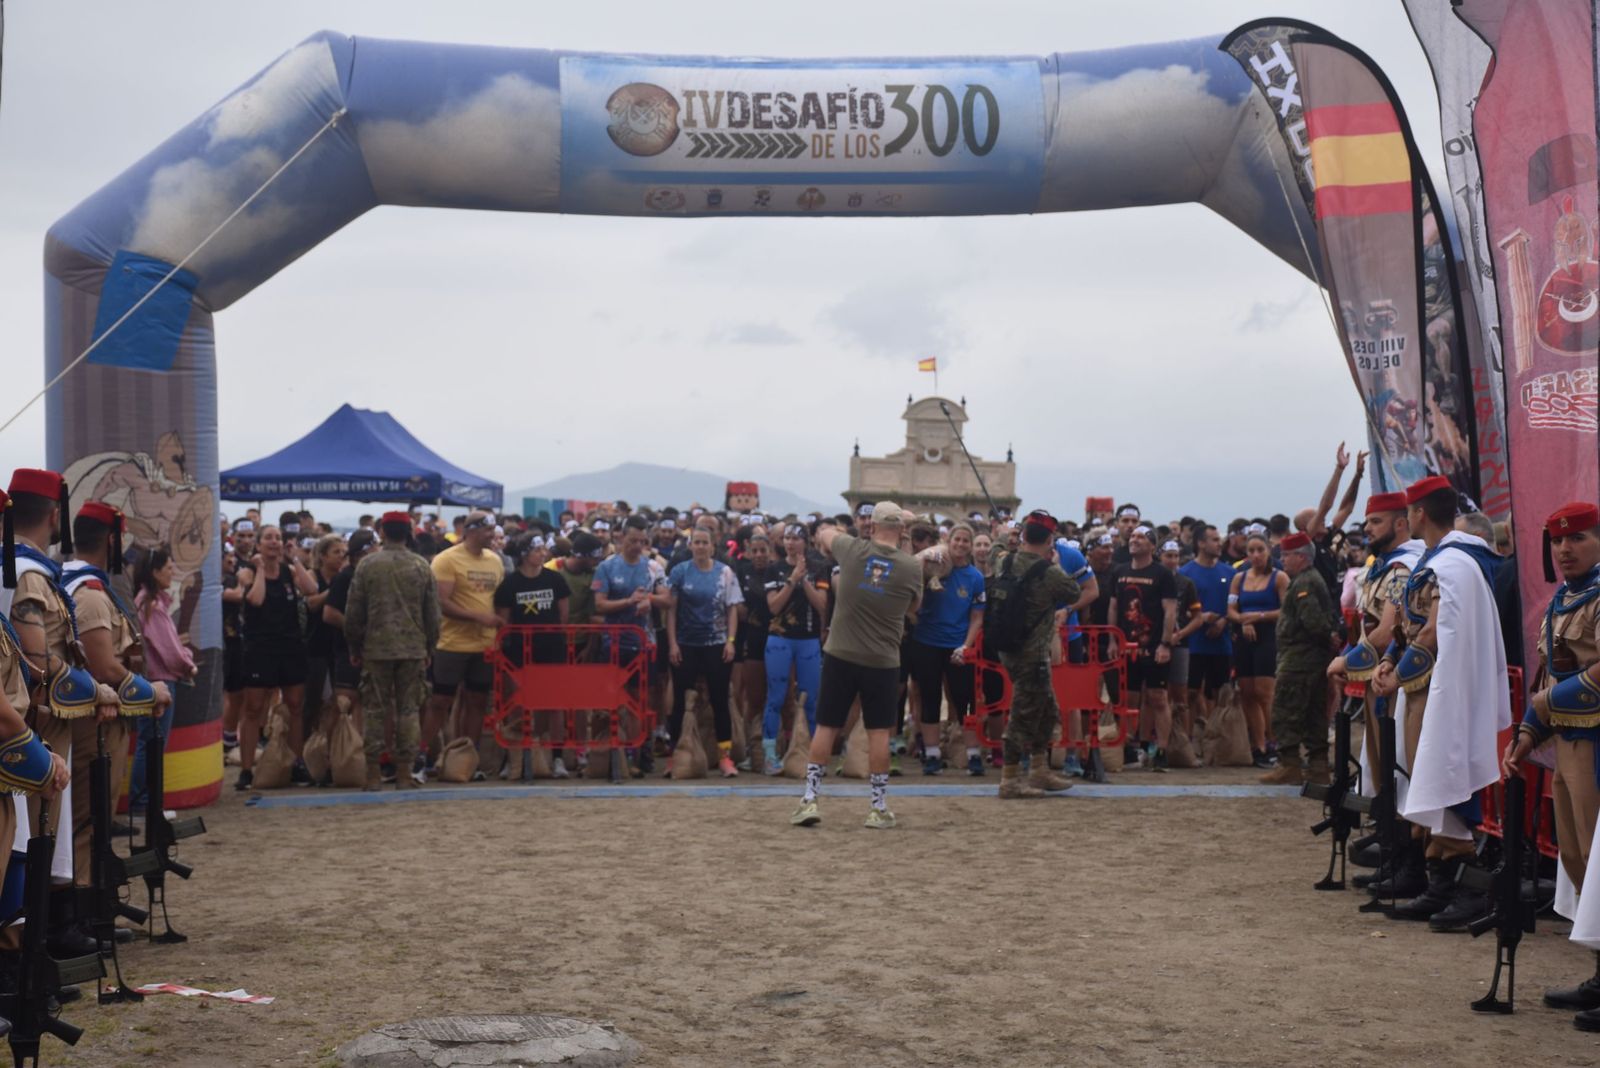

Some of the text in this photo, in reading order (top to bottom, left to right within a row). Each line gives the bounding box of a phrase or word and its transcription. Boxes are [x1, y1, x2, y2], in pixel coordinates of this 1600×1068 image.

[884, 83, 1000, 158] 300
[811, 134, 880, 159] DE LOS
[517, 591, 552, 602] HERMES
